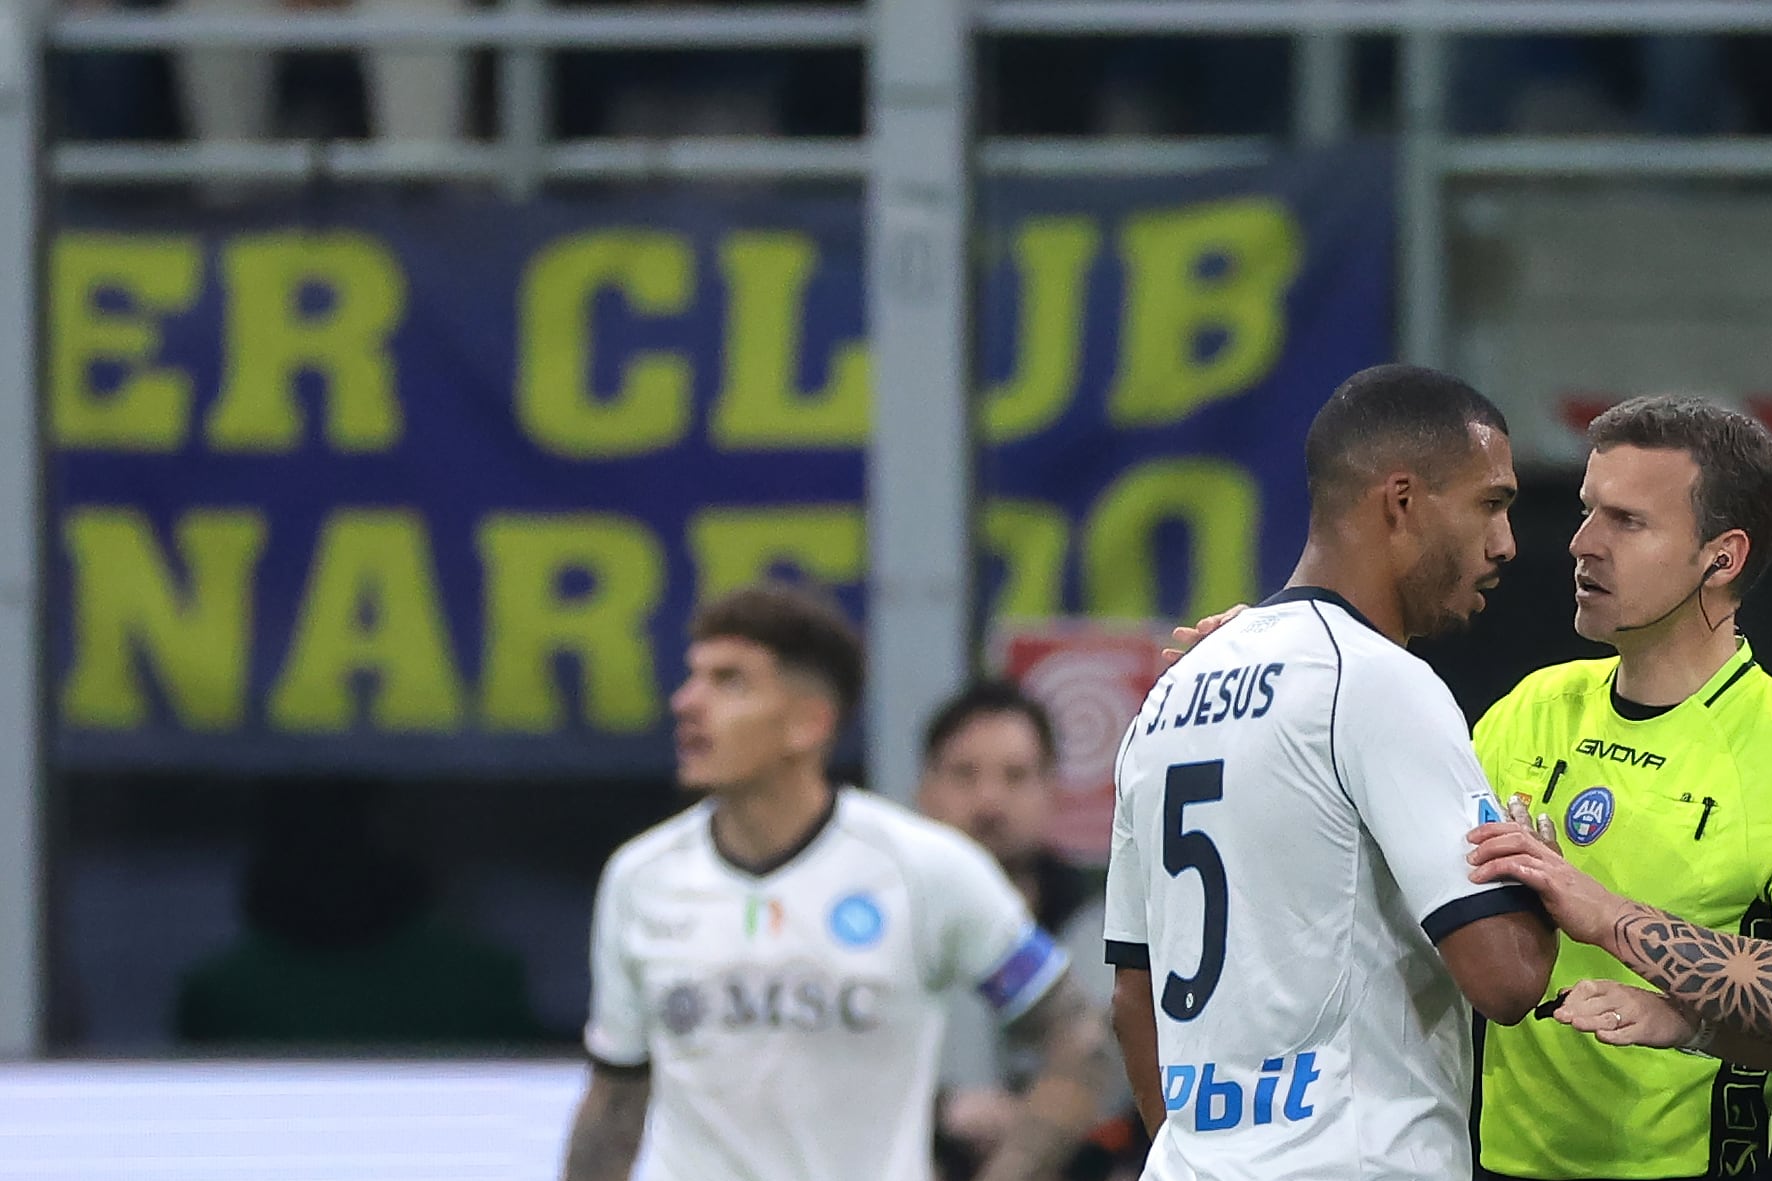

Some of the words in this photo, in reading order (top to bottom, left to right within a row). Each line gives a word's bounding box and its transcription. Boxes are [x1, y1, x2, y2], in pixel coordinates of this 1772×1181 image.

[1174, 662, 1285, 729] JESUS
[1576, 738, 1666, 770] GIVOVA
[1161, 759, 1229, 1023] 5
[723, 978, 884, 1034] MSC
